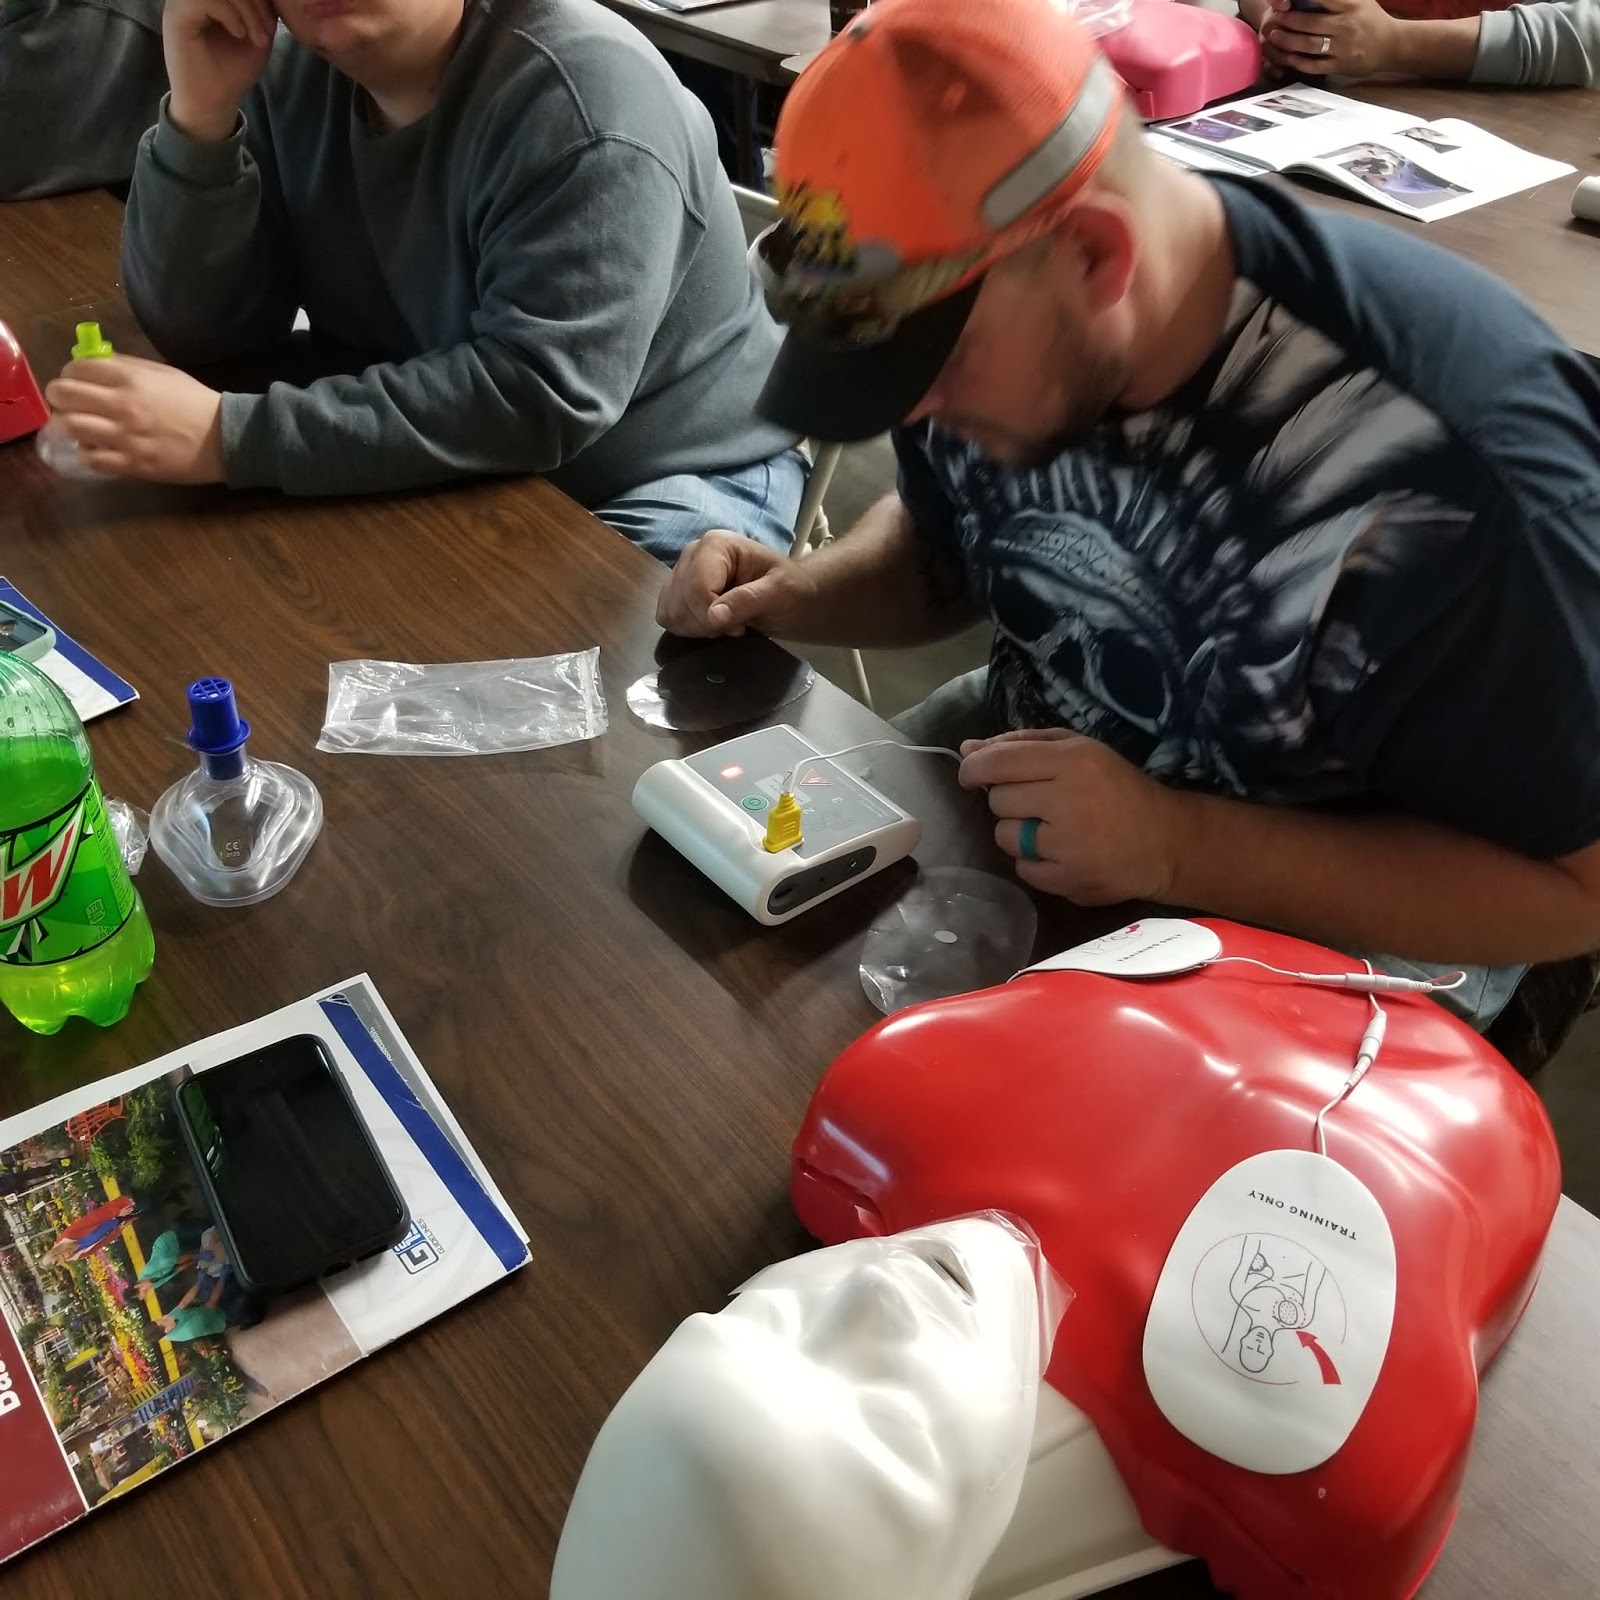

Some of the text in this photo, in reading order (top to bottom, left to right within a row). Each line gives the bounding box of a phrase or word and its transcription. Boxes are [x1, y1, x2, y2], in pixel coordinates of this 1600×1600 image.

[225, 841, 241, 851] CE
[1117, 933, 1182, 962] TRAINING ONLY
[1248, 1189, 1357, 1241] TRAINING ONLY
[416, 1218, 445, 1255] GUIDELINES
